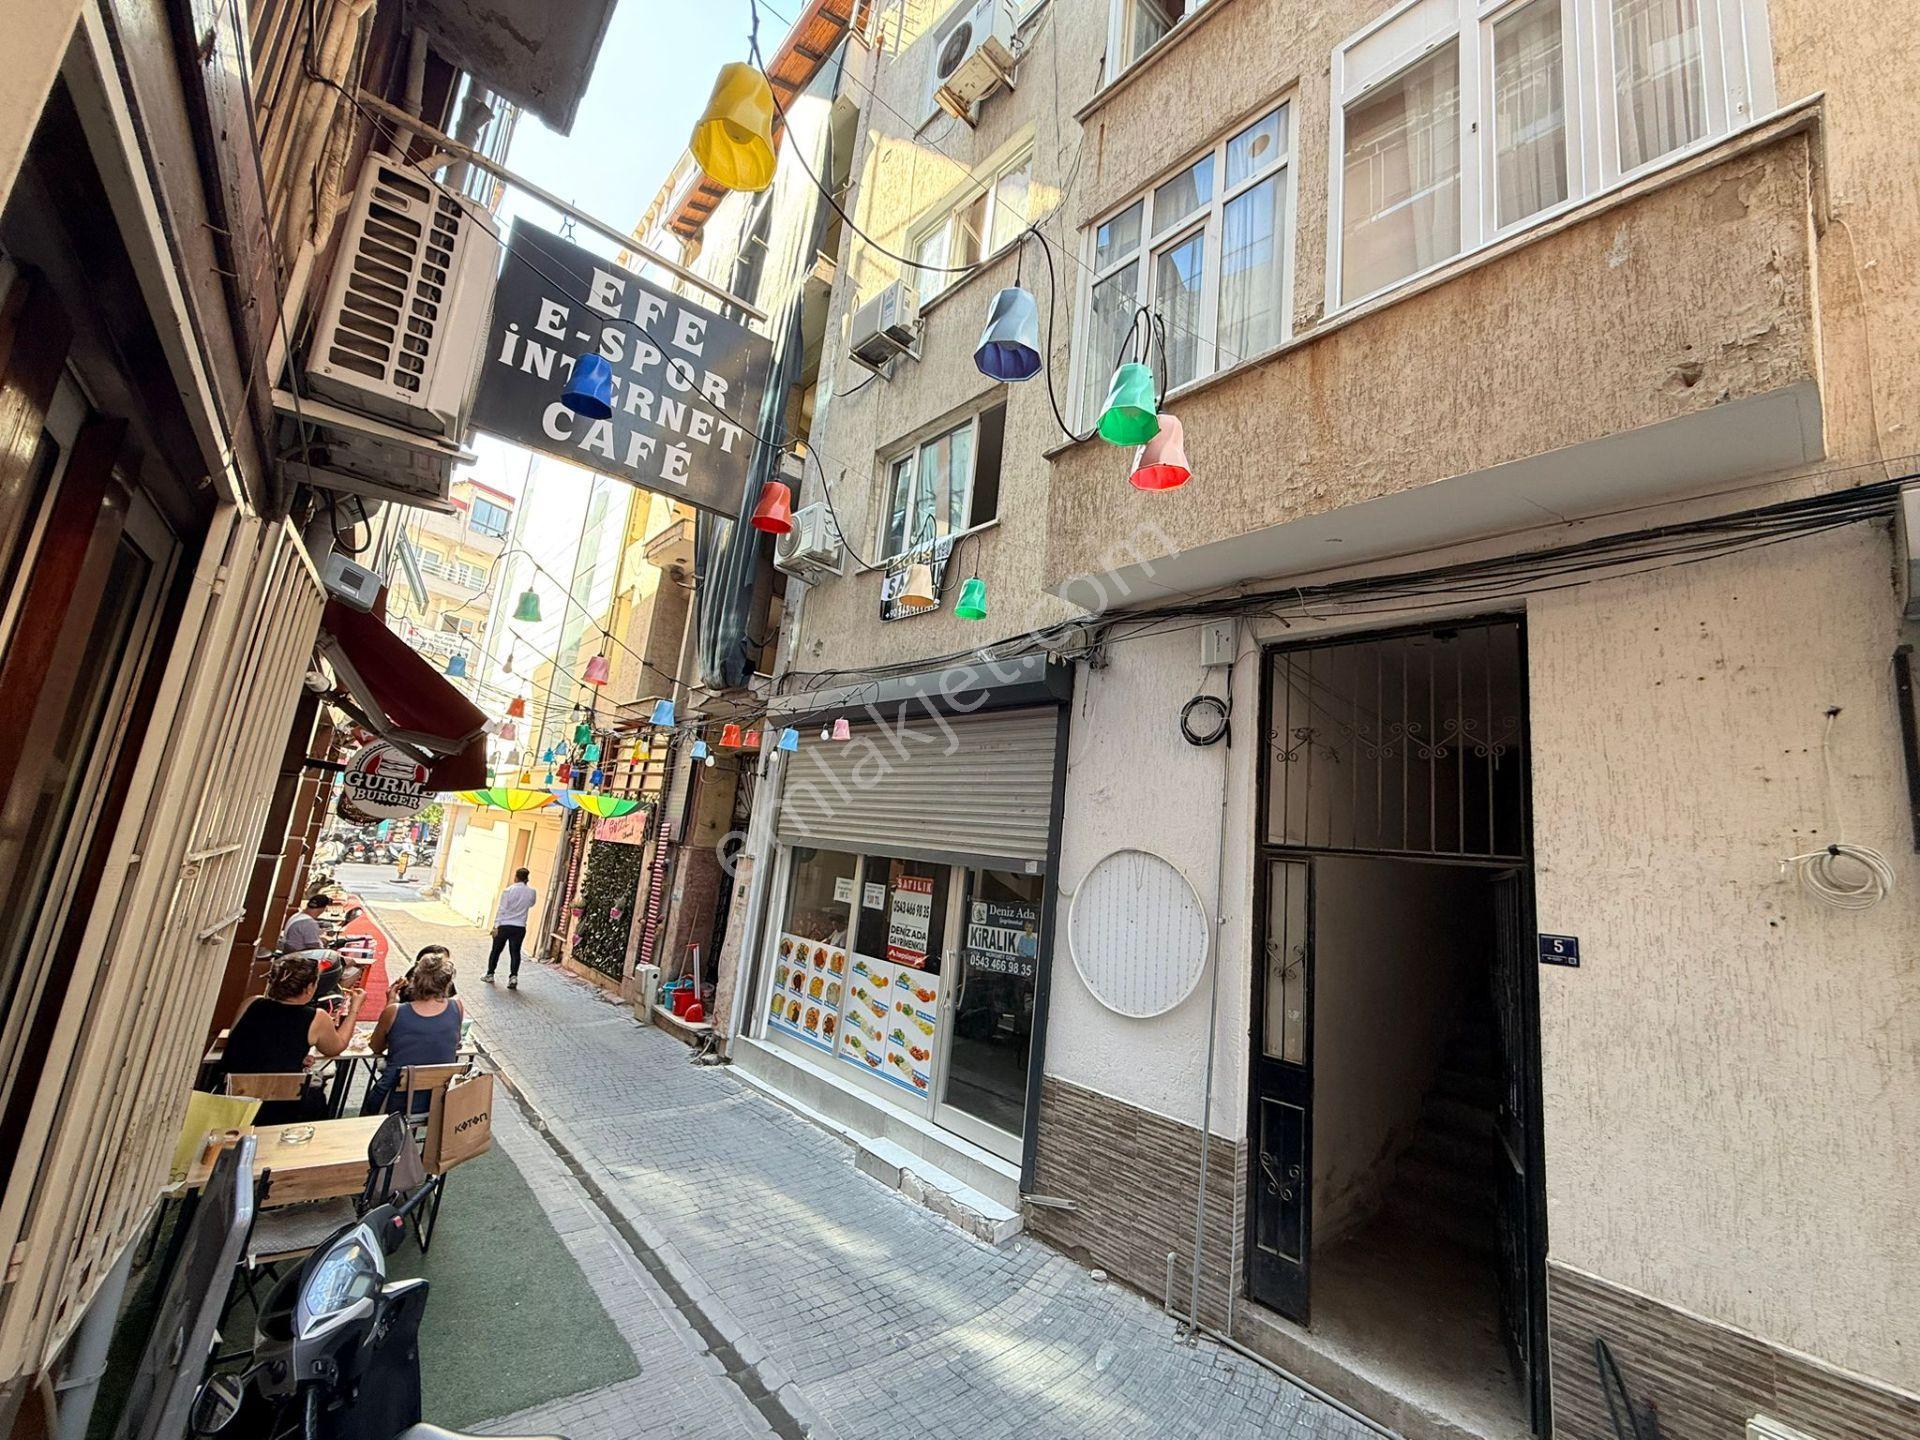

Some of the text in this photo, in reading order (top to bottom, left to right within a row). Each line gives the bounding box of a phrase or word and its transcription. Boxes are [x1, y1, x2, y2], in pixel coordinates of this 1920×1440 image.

[585, 266, 708, 357] EFE
[534, 297, 730, 410] E-SPOR
[542, 401, 692, 487] CAFÉ
[354, 788, 420, 809] BURGER
[897, 878, 932, 893] SATILIK
[990, 904, 1036, 919] Deniz Ada
[1553, 939, 1564, 953] 5
[970, 954, 990, 968] 0543
[991, 959, 1006, 972] 466
[1008, 962, 1019, 974] 98
[1021, 964, 1032, 977] 35
